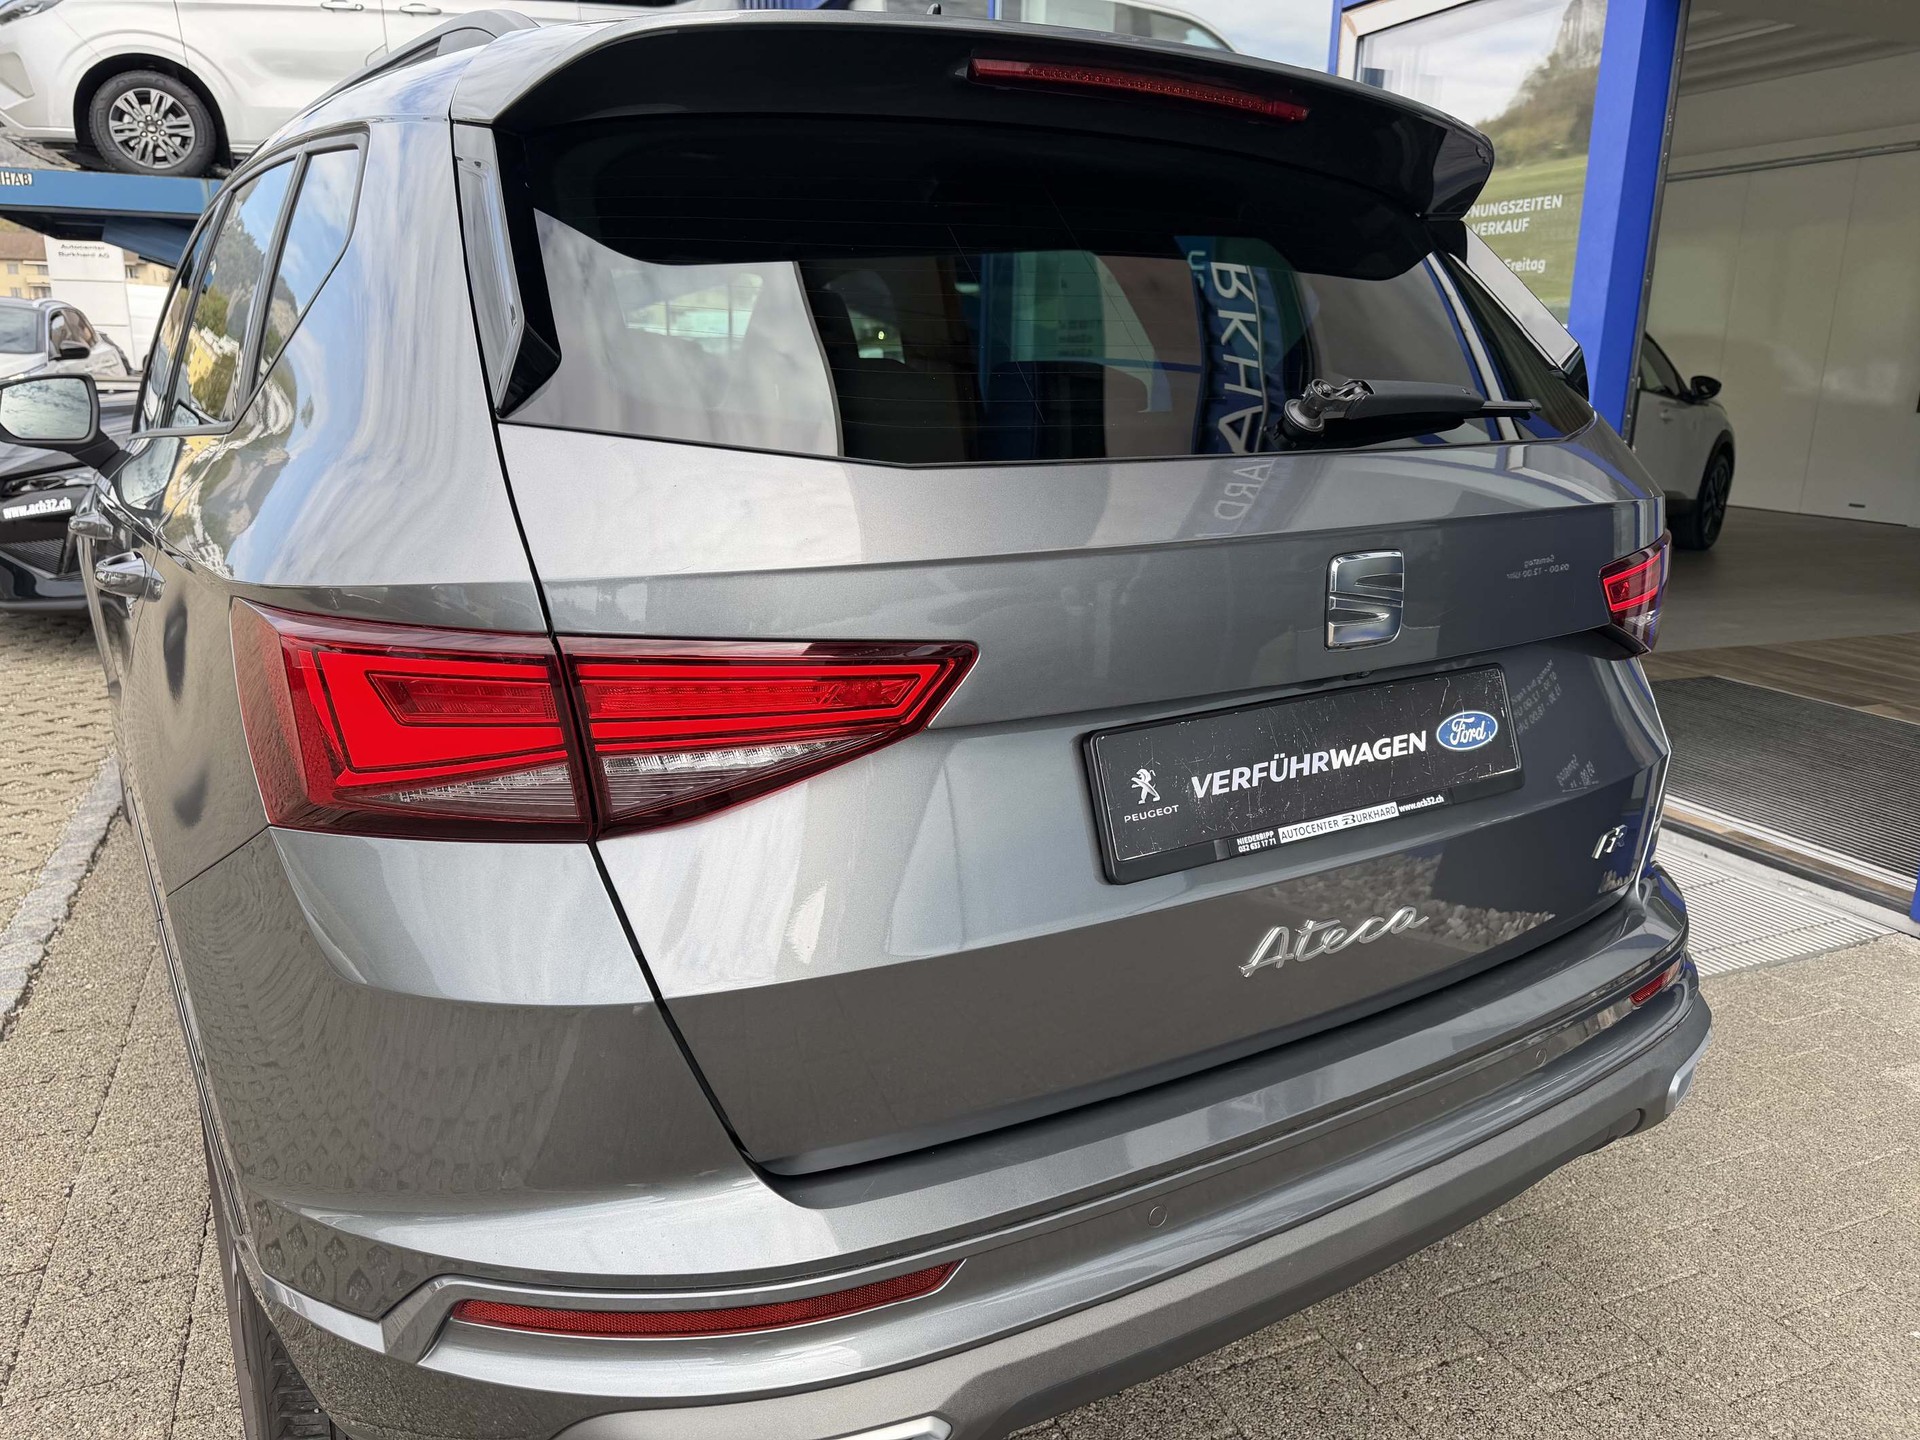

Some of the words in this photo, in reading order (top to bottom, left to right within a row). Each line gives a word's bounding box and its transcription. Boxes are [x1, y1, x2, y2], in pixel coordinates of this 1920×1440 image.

[1472, 218, 1530, 236] VERKAUF
[1191, 730, 1427, 799] VERFÜHRWAGEN
[1449, 716, 1487, 745] Ford
[1124, 804, 1180, 823] PEUGEOT
[1236, 830, 1275, 845] NIEDERBIPP
[1281, 819, 1339, 840] AUTOCENTER
[1238, 843, 1250, 853] 032
[1238, 904, 1430, 978] Ateca
